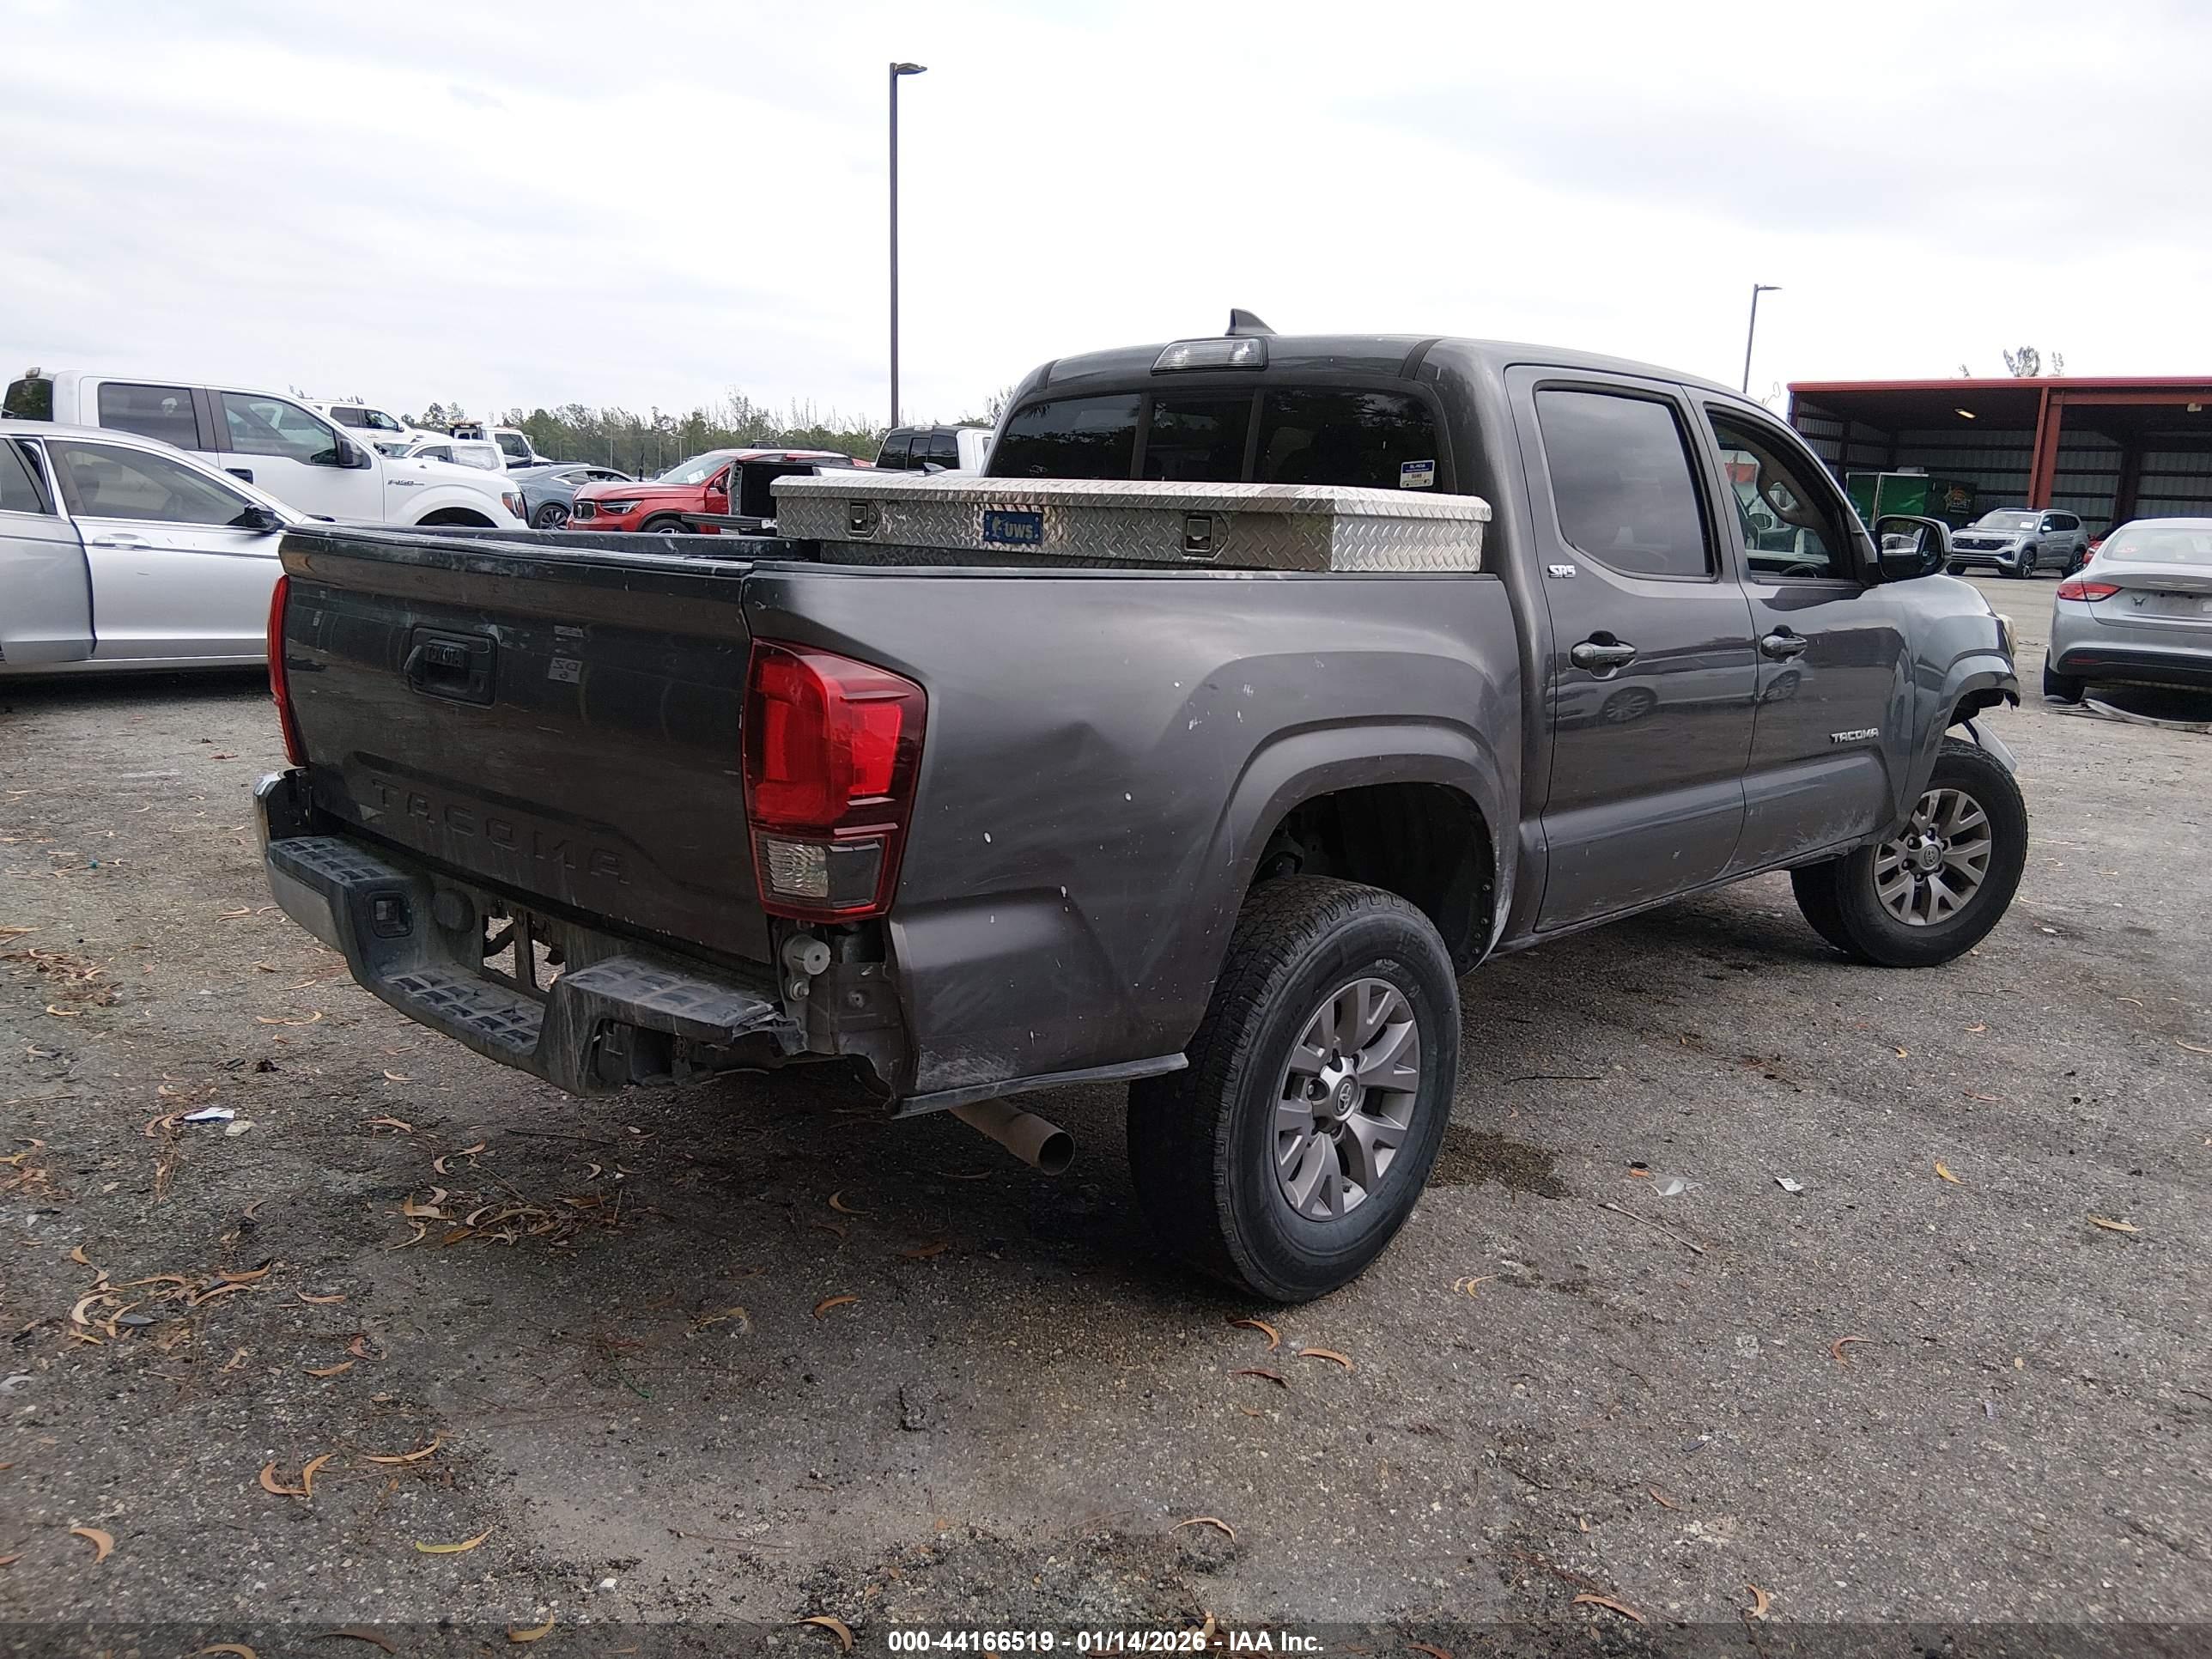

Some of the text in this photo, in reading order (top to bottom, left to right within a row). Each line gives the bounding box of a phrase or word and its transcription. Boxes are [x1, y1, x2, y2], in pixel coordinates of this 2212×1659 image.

[1004, 521, 1034, 539] UWS
[1547, 564, 1577, 578] SR5
[1830, 727, 1880, 743] TACOMA
[371, 778, 631, 885] TACOMA
